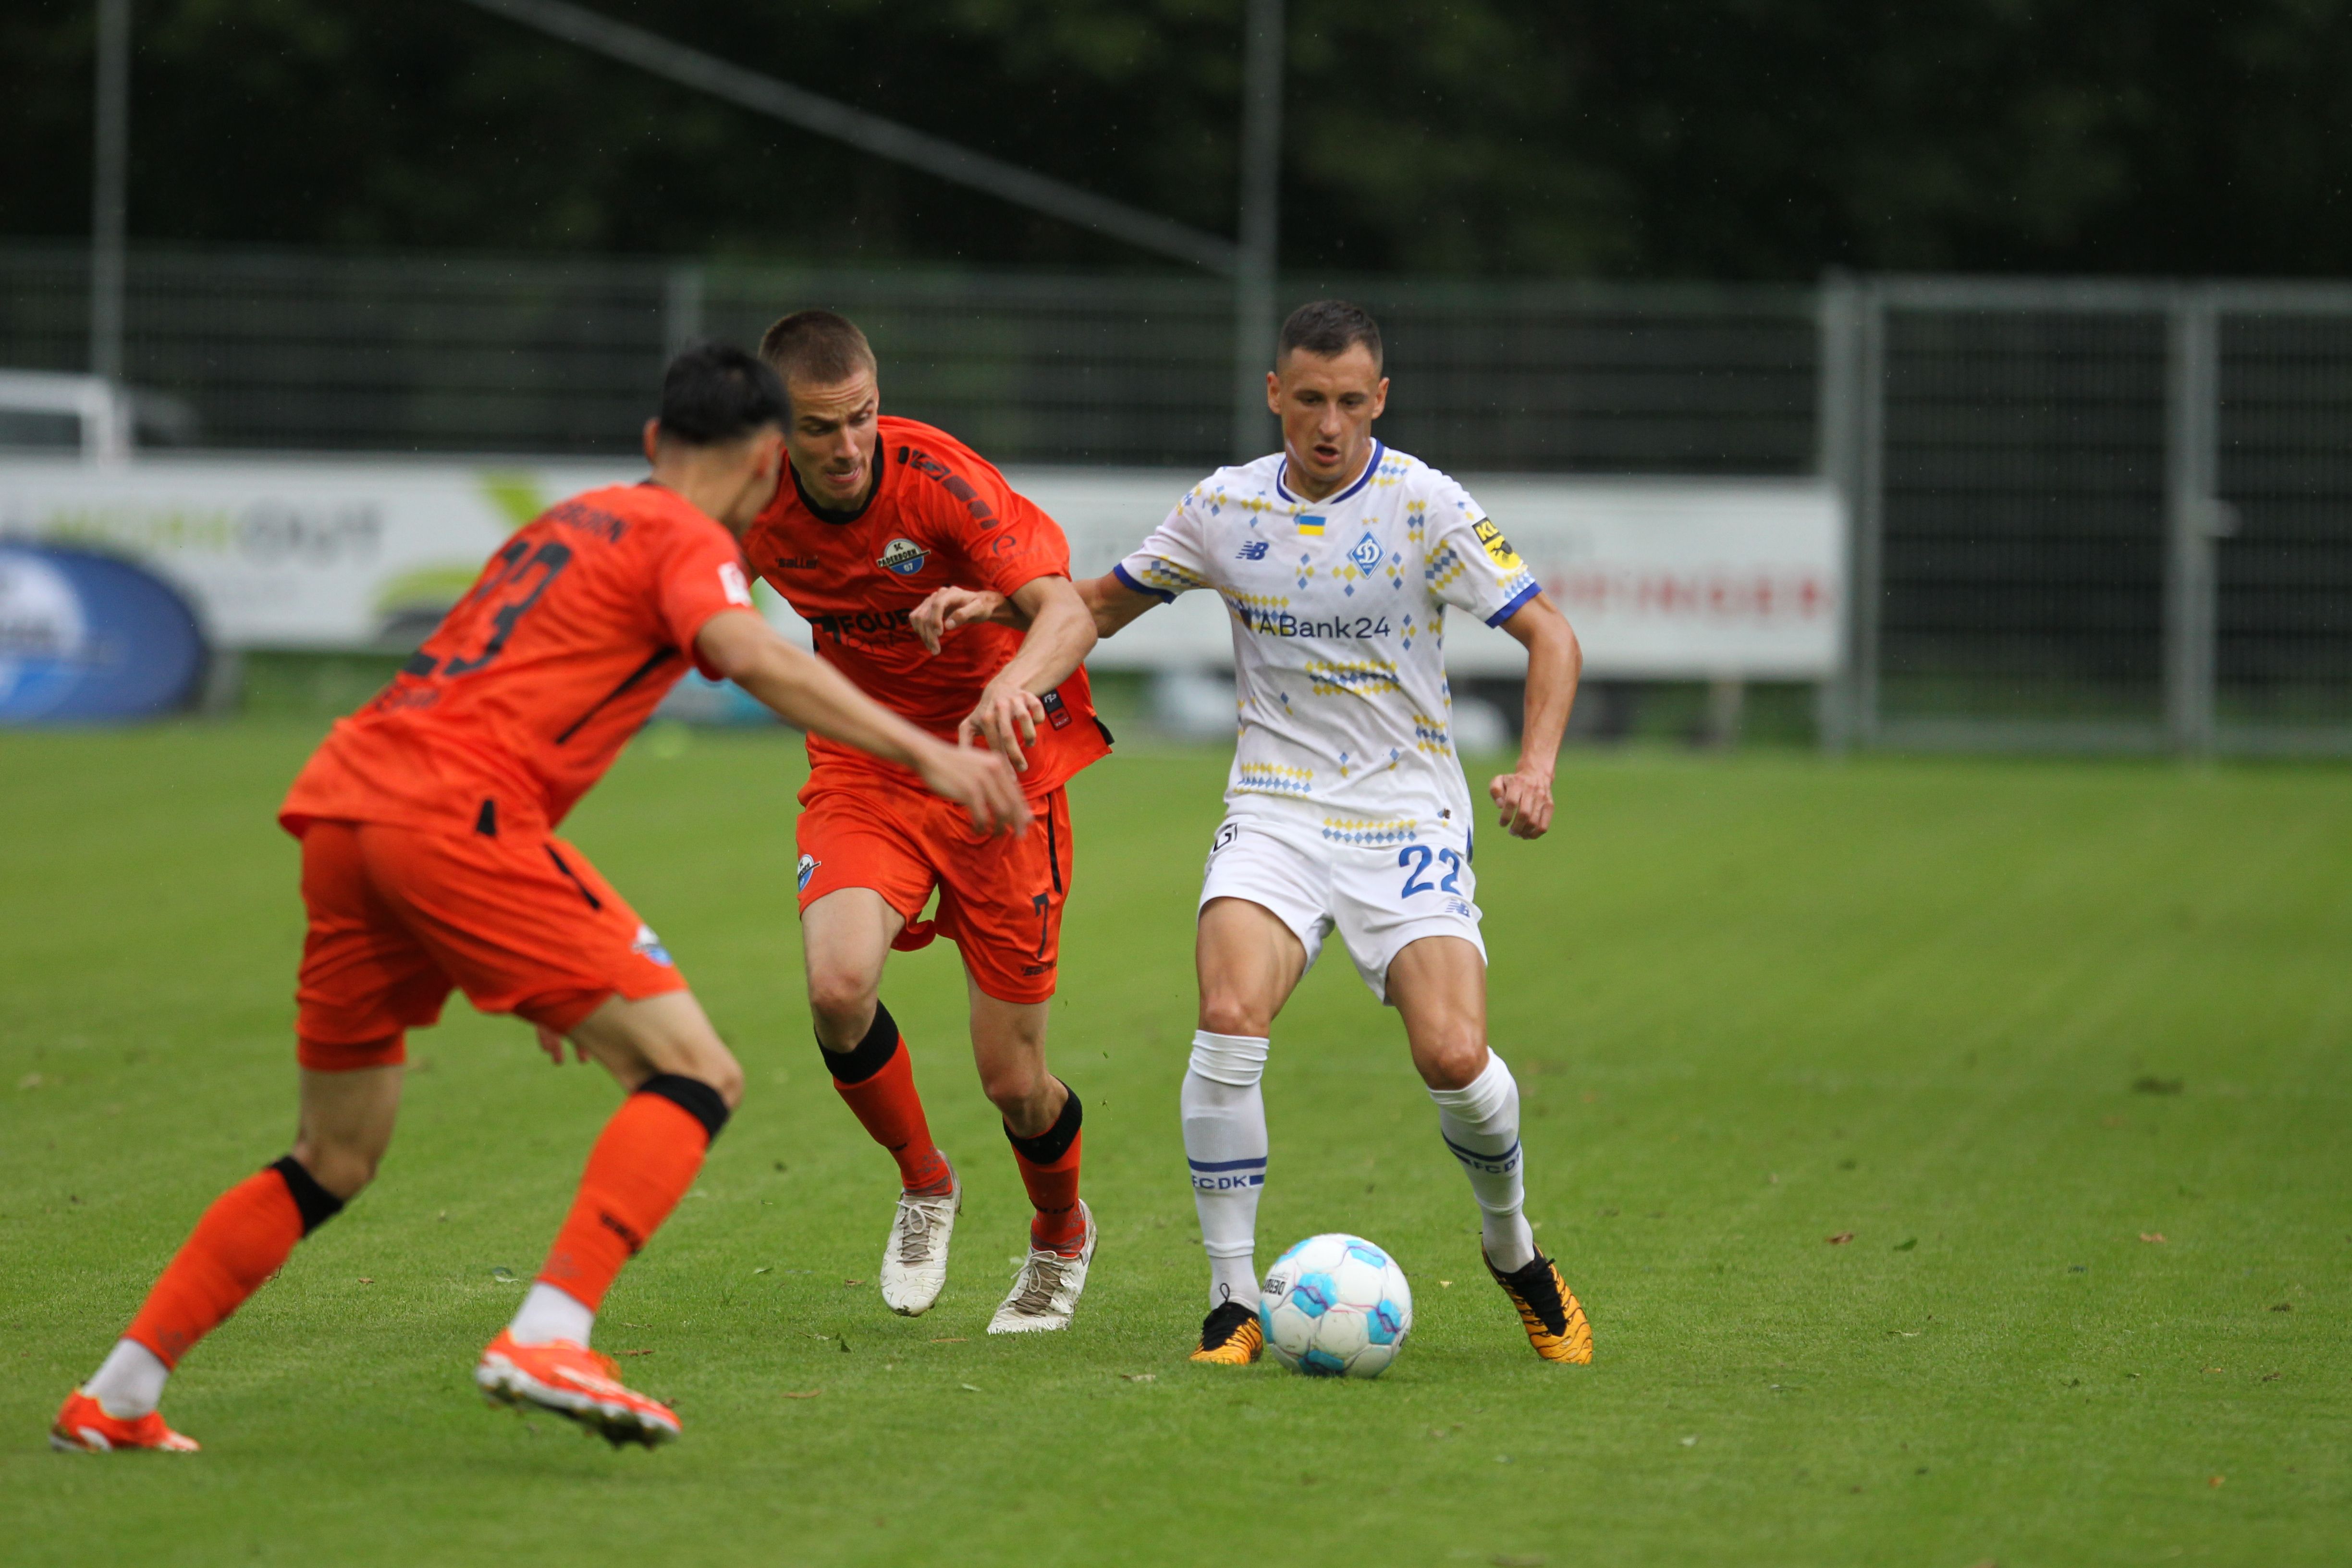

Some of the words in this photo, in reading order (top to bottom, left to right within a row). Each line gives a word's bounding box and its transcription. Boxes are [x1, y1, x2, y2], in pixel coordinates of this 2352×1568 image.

[877, 548, 918, 567] PADERBORN
[1259, 614, 1391, 638] ABank24
[1398, 845, 1463, 900] 22
[1032, 892, 1050, 959] 7
